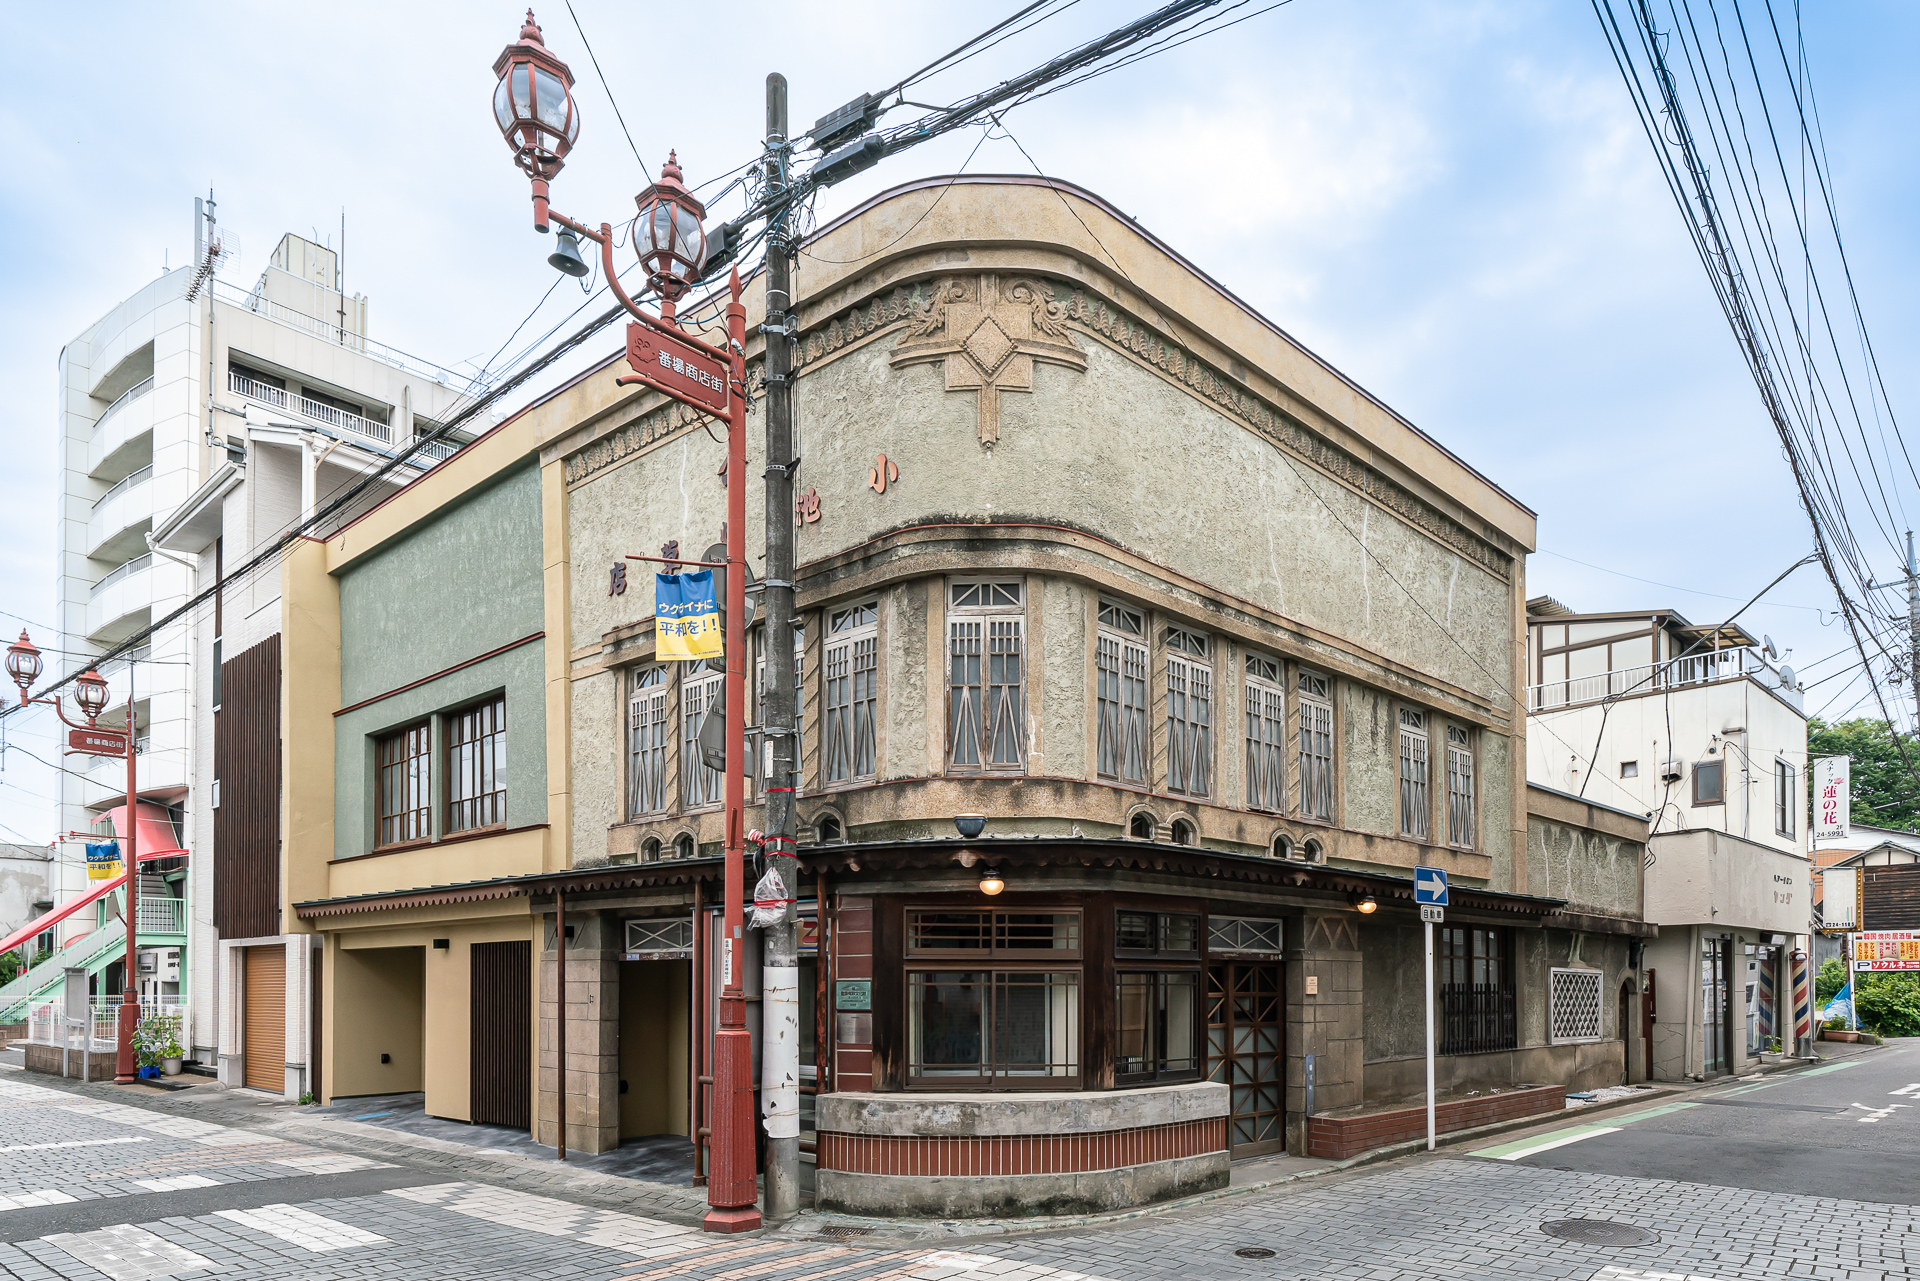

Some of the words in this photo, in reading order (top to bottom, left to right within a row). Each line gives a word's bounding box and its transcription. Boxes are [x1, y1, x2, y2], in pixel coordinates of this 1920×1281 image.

[658, 349, 724, 394] 番場商店街
[658, 599, 714, 615] ウクライナに
[1826, 760, 1834, 785] スナック
[1822, 785, 1838, 825] 蓮の花
[1872, 960, 1906, 969] ソウル亭
